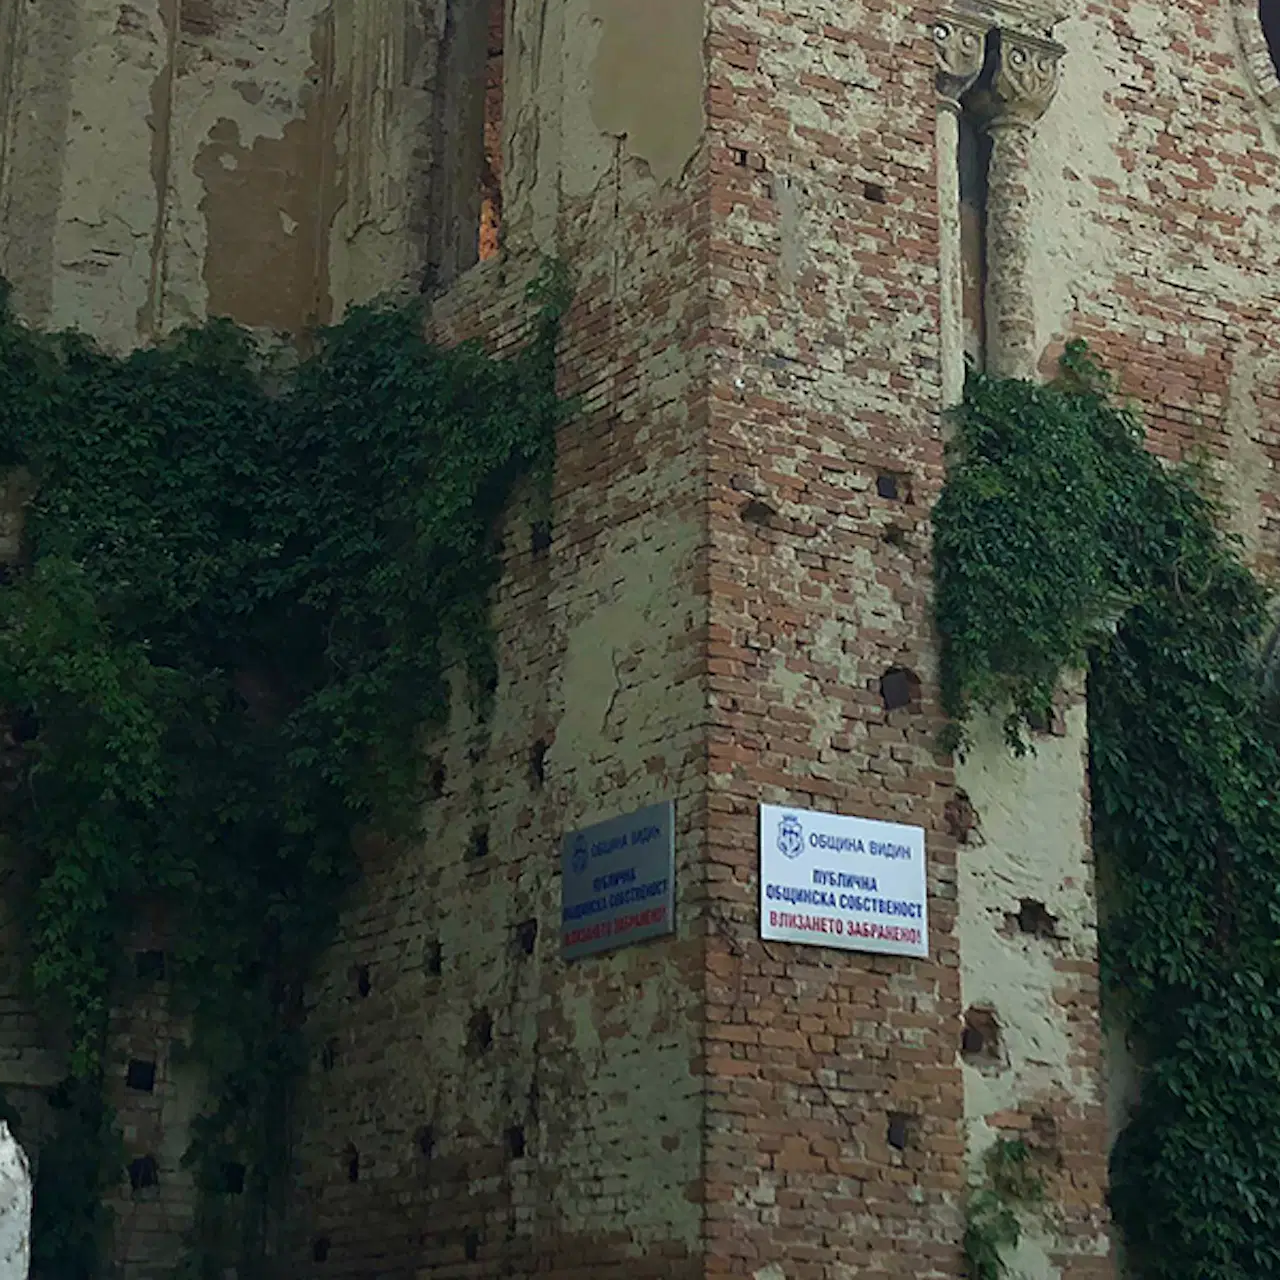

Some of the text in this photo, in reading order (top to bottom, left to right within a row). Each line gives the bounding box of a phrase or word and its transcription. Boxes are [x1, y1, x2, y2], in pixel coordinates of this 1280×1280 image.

[809, 832, 912, 860] ОБЩИНА ВИДИН
[812, 868, 878, 892] ПУБЛИЧНА
[766, 884, 923, 919] ОБЩИНСКА СОБСТВЕНОСТ
[769, 910, 922, 944] ВЛИЗАНЕТО ЗАБРАНЕНО!
